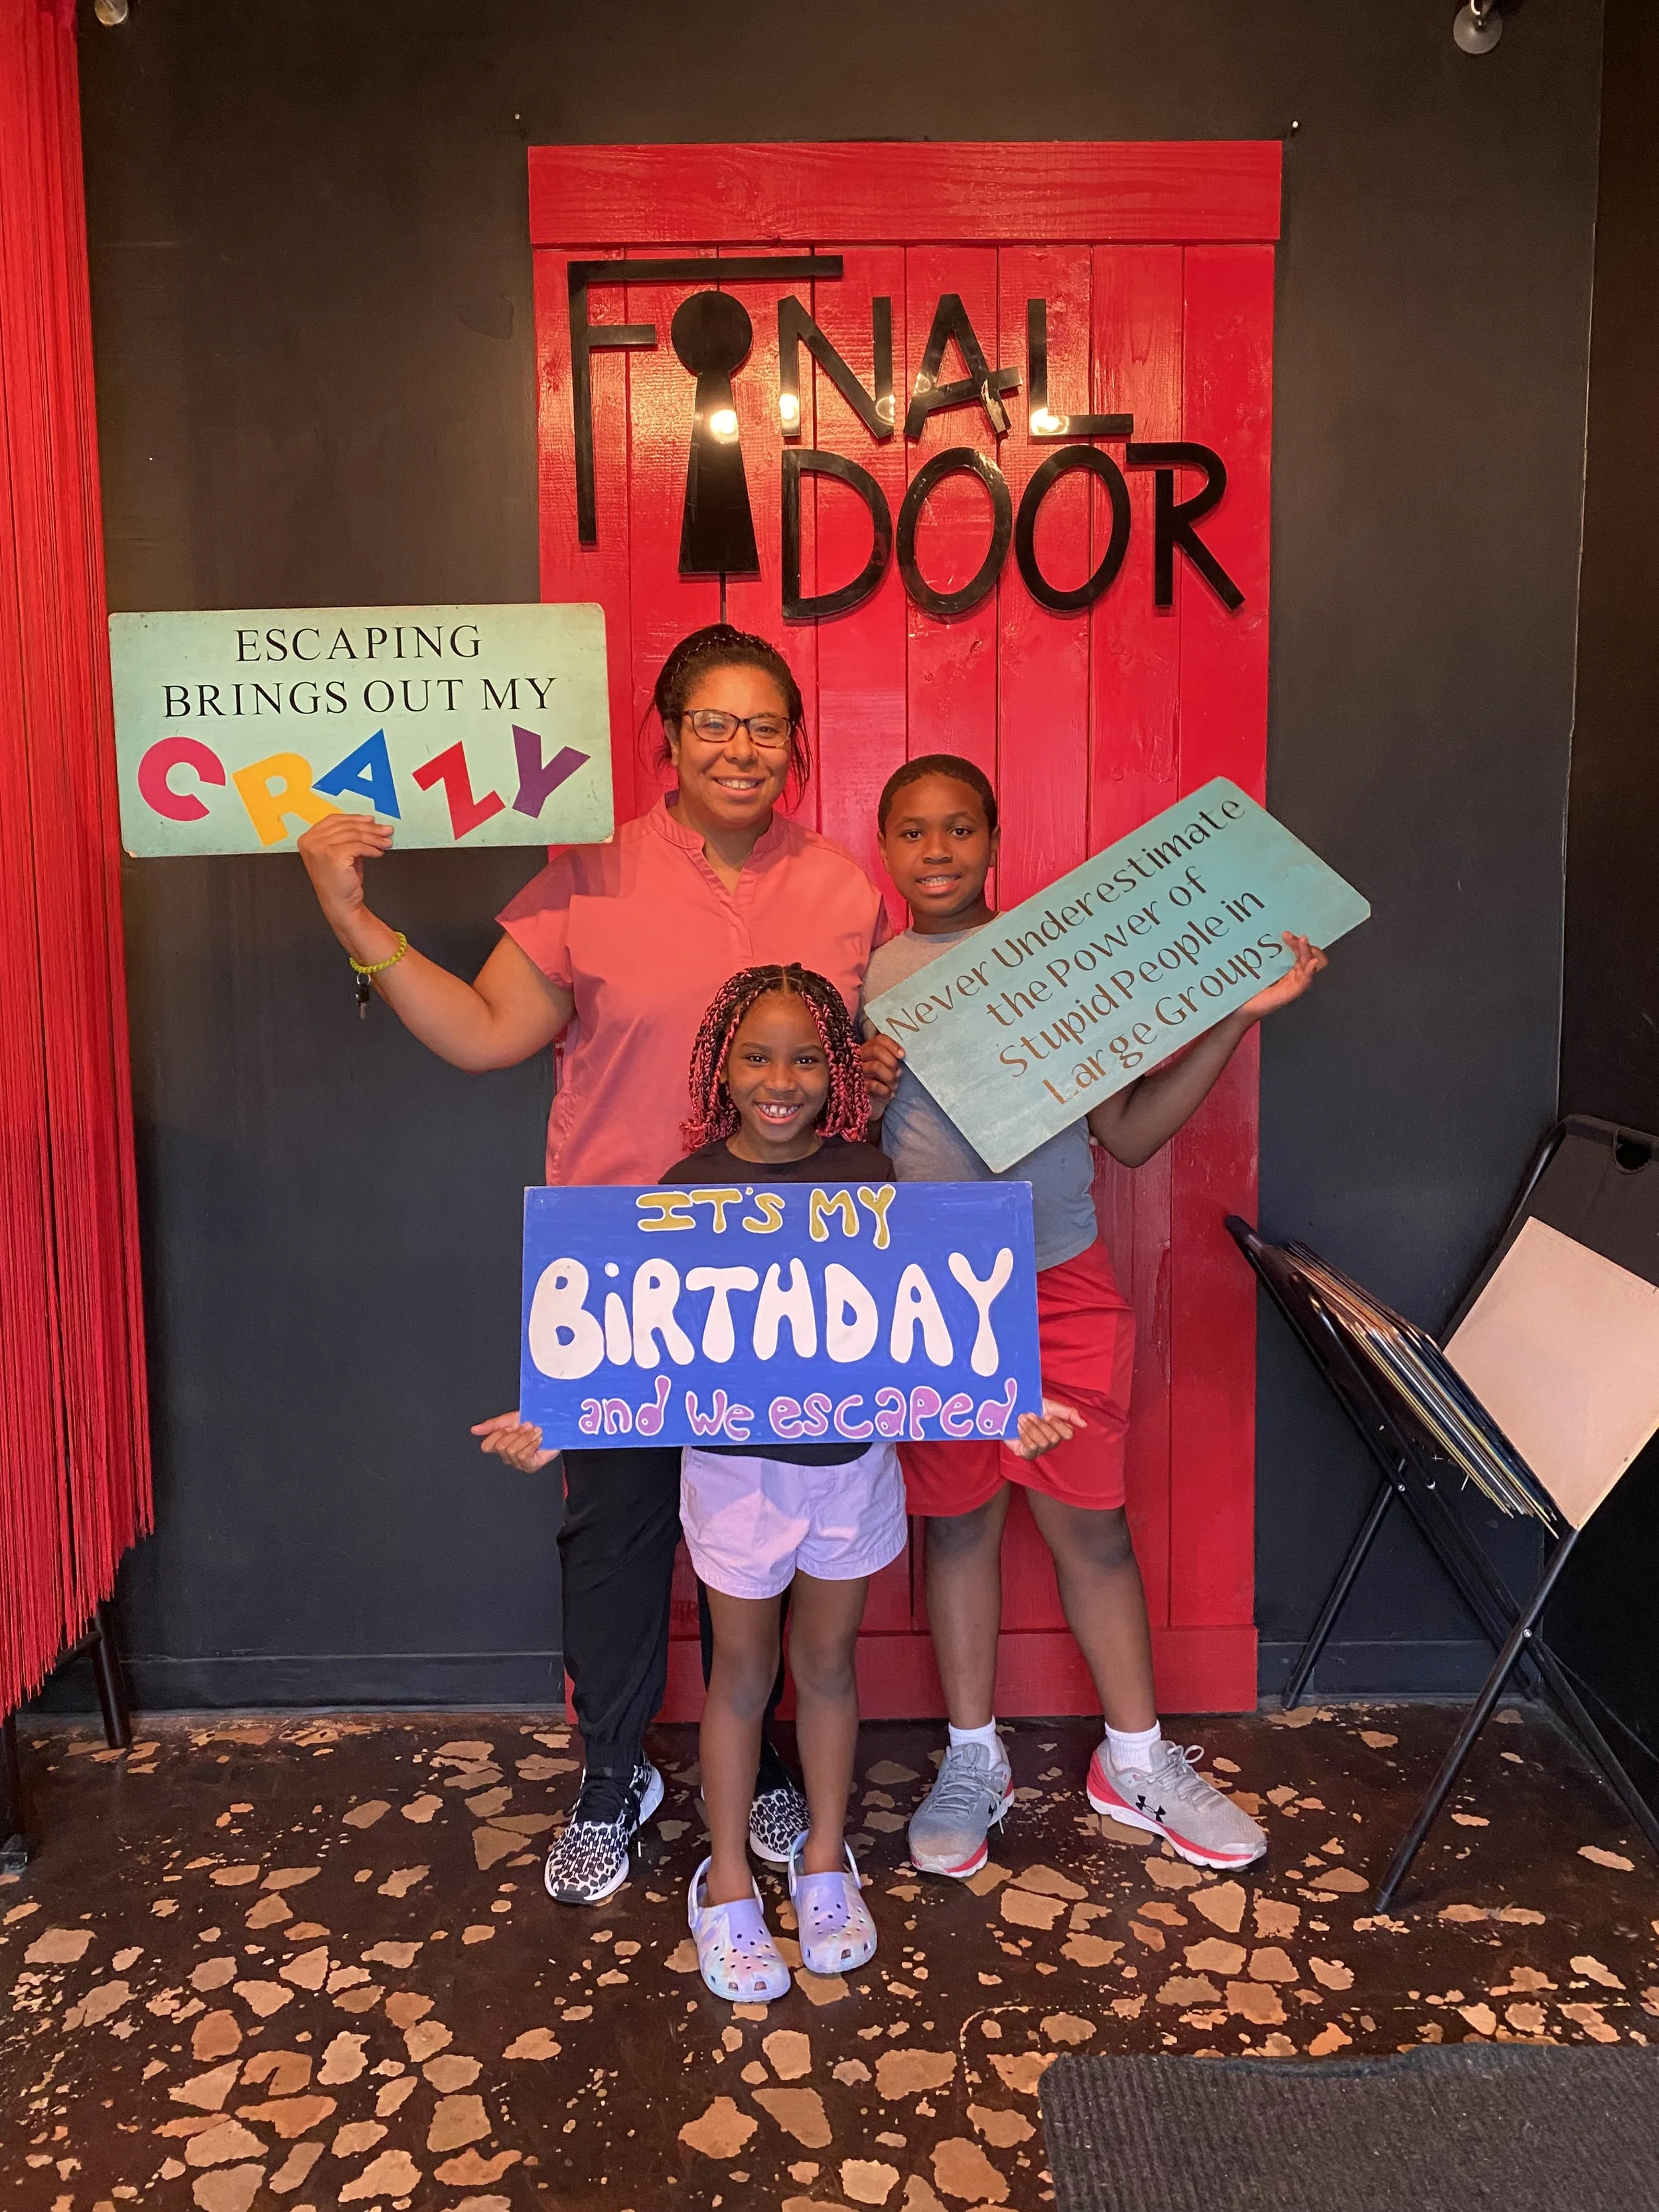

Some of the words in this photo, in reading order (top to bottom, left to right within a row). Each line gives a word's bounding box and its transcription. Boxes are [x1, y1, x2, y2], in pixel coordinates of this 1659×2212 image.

[782, 441, 1245, 619] DOOR
[162, 681, 348, 718] BRINGS
[364, 679, 464, 713] OUT
[481, 677, 557, 711] MY
[236, 625, 482, 662] ESCAPING
[137, 723, 591, 846] CRAZY
[885, 958, 989, 1041] Never
[992, 798, 1246, 969] Underestimate
[986, 980, 1052, 1027] the
[1046, 900, 1161, 988] Power
[1168, 865, 1207, 907] of
[999, 984, 1124, 1078] Stupid
[1110, 917, 1229, 1000] People
[1220, 889, 1265, 929] in
[1042, 1025, 1157, 1105] Large
[1155, 931, 1283, 1026] Groups
[635, 1186, 785, 1234] IT'S
[809, 1184, 896, 1250] MY
[579, 1374, 671, 1436] and
